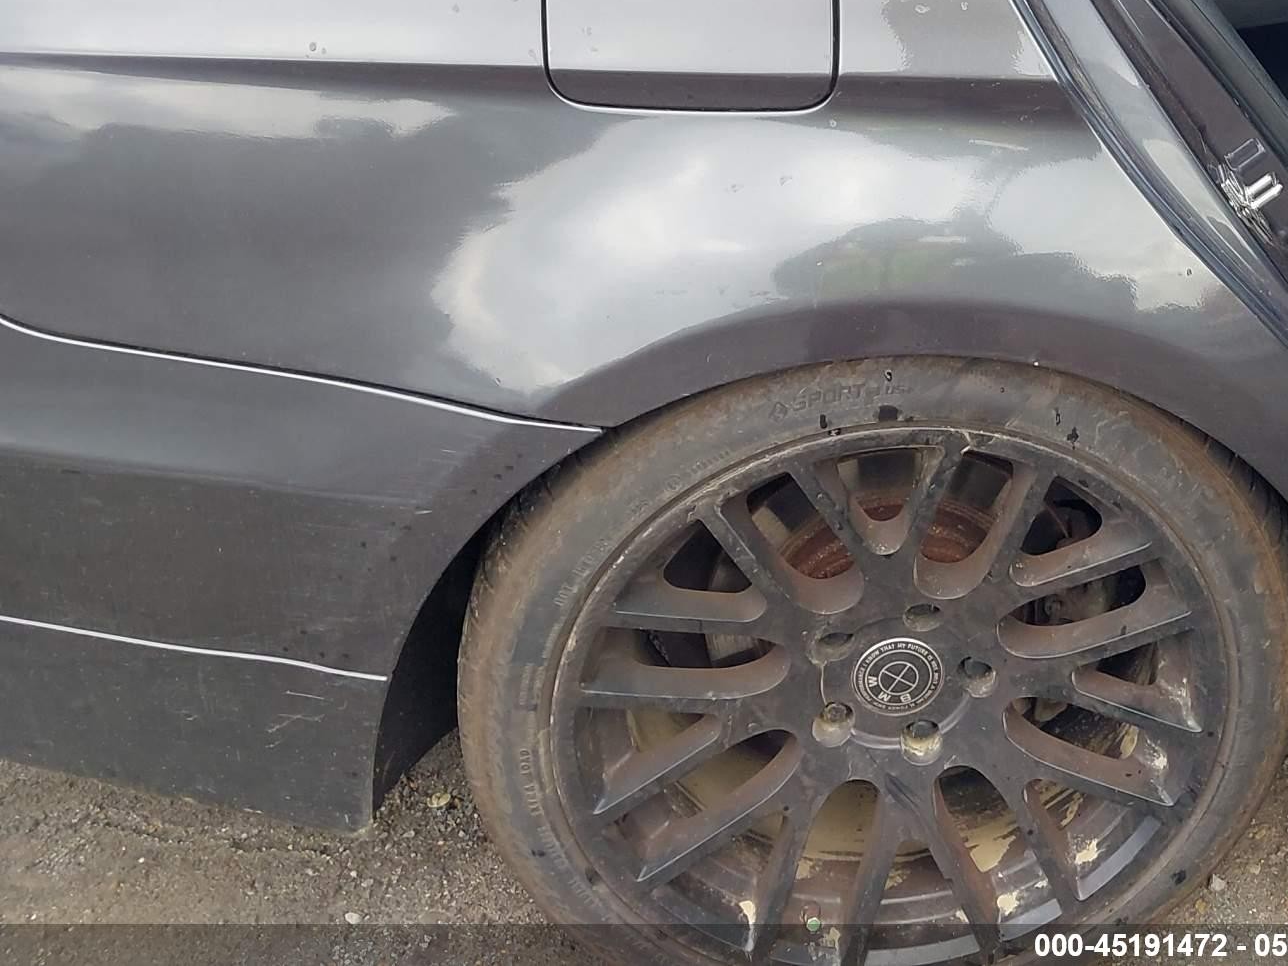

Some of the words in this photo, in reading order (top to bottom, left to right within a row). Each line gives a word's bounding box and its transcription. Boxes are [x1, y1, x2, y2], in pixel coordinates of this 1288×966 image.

[792, 382, 866, 412] SPORT
[880, 643, 895, 652] THAT
[907, 643, 928, 656] FUTURE
